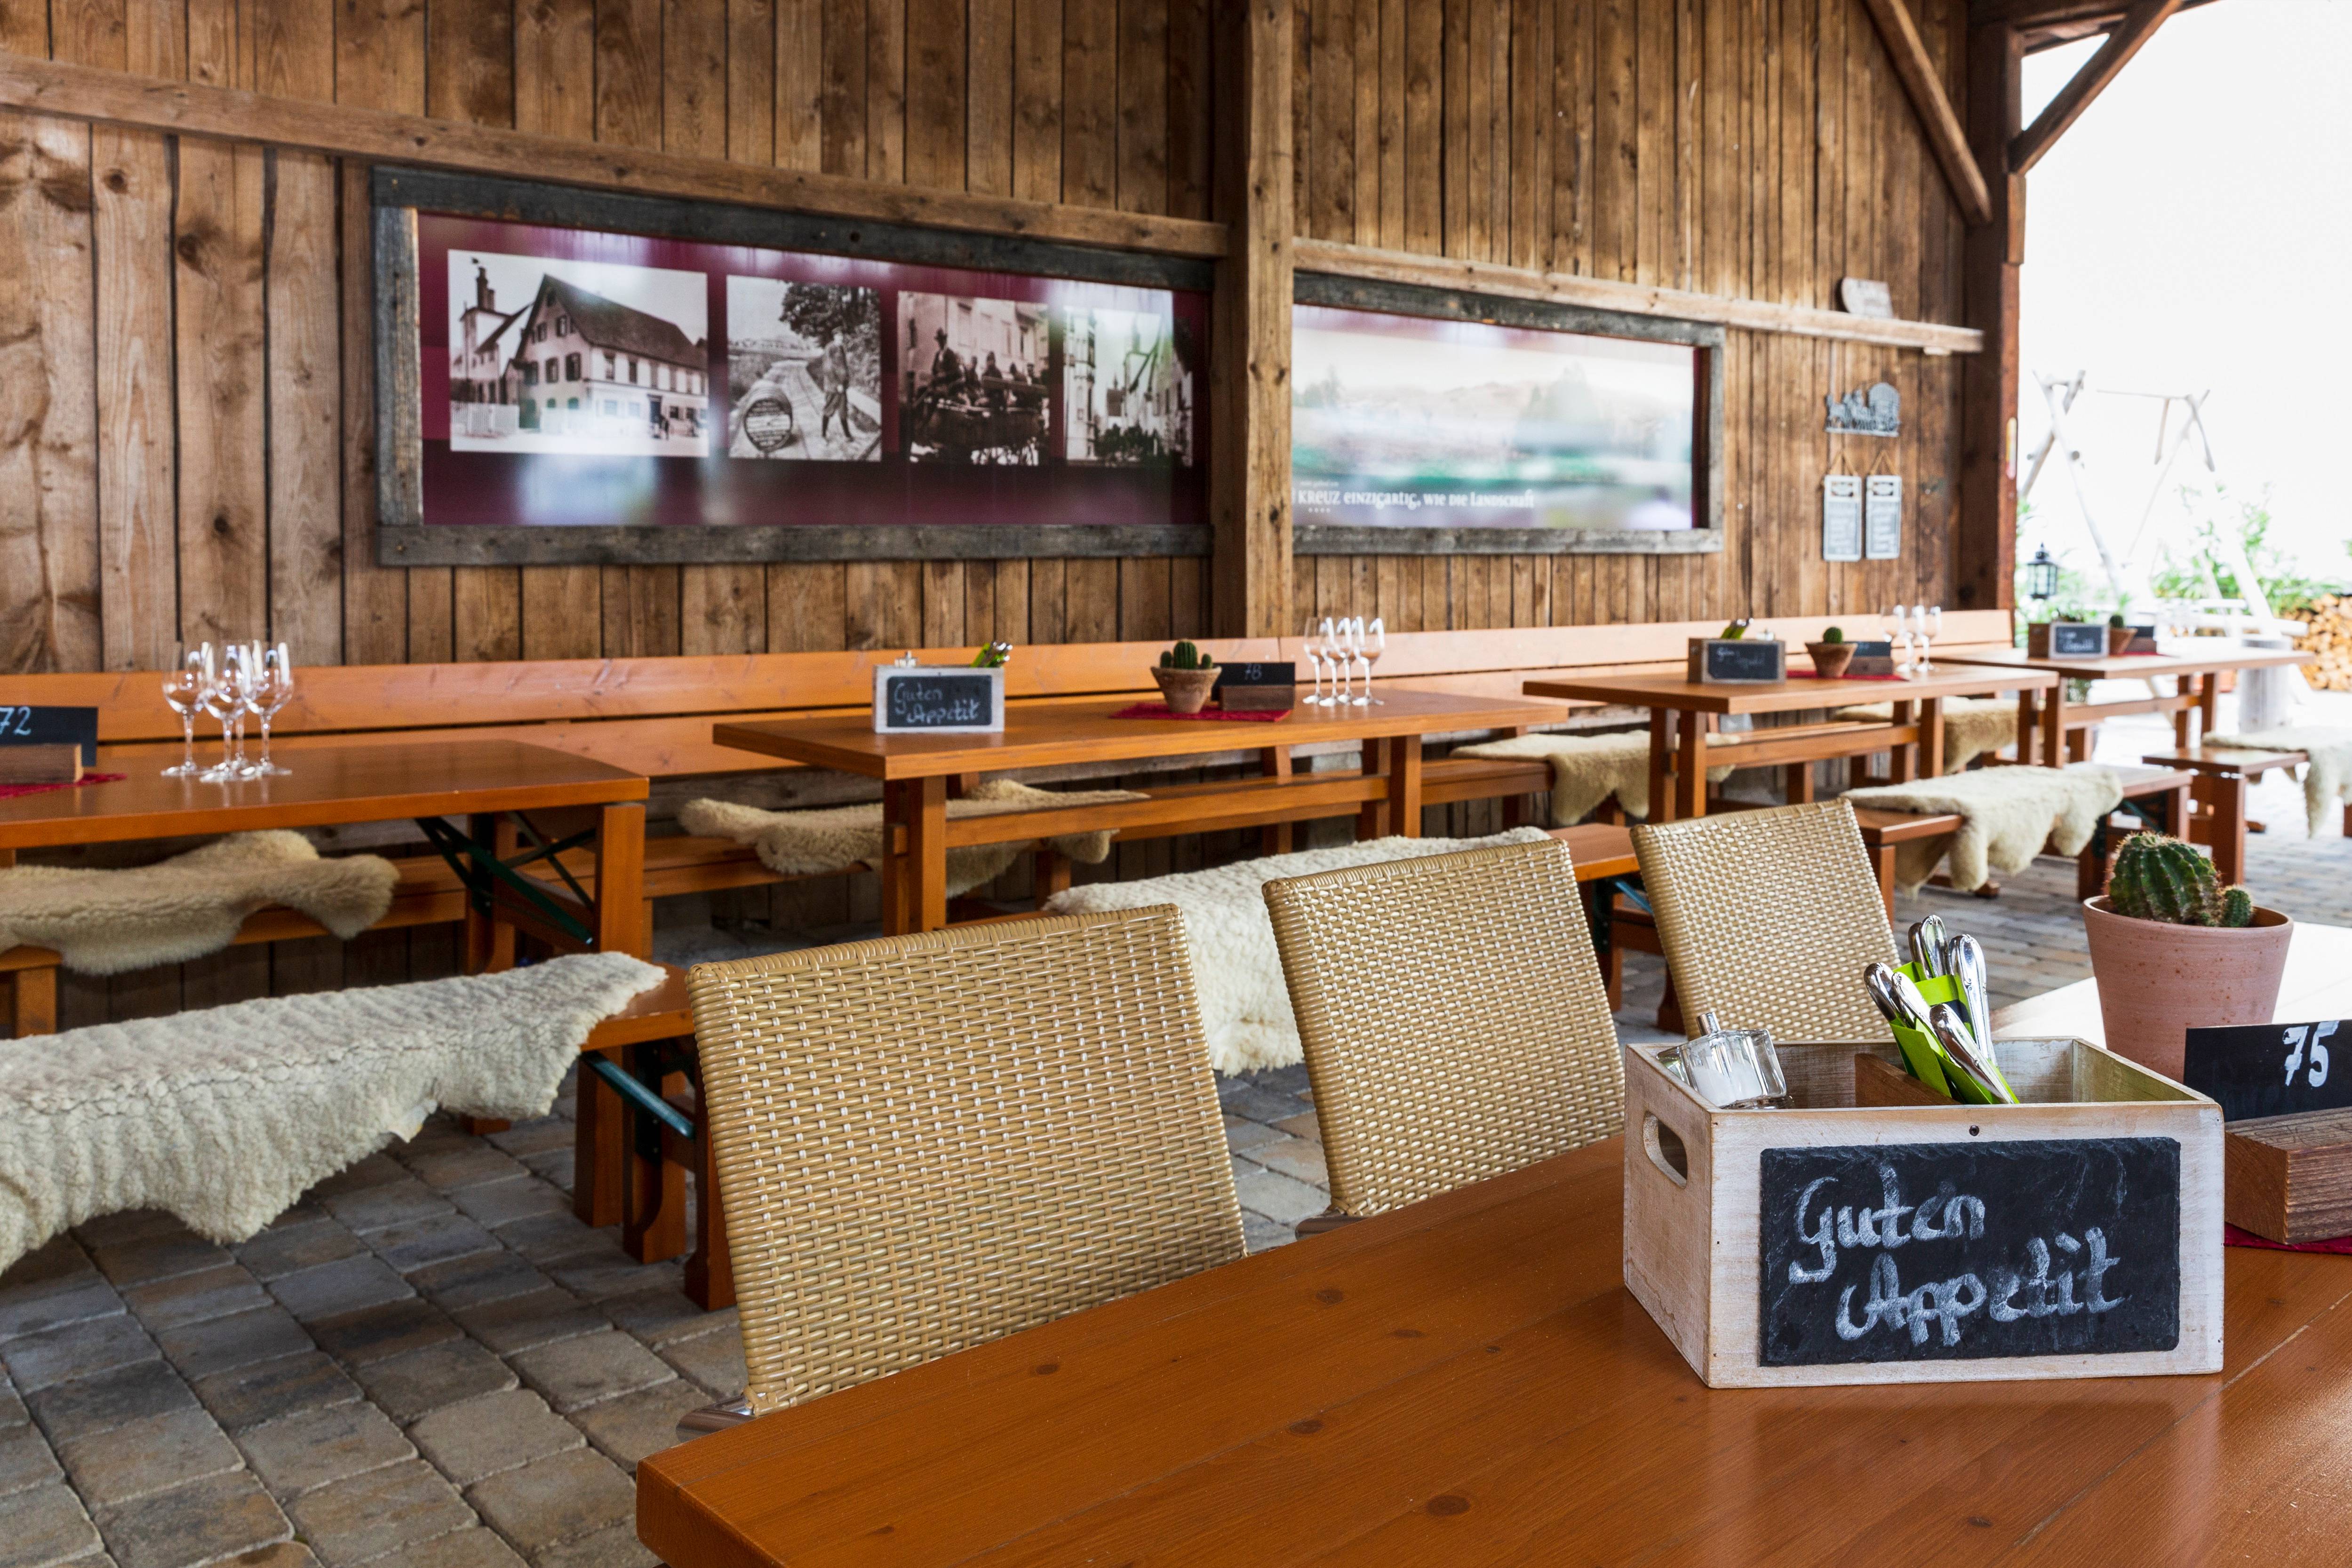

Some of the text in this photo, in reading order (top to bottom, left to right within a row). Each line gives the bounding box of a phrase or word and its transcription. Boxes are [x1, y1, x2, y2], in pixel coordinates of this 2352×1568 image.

[0, 706, 32, 735] 72
[894, 683, 942, 715] Guten
[906, 699, 979, 723] Appetit
[2282, 1021, 2339, 1087] 75
[1789, 1166, 1985, 1284] Guten
[1836, 1227, 2131, 1347] Appetit
